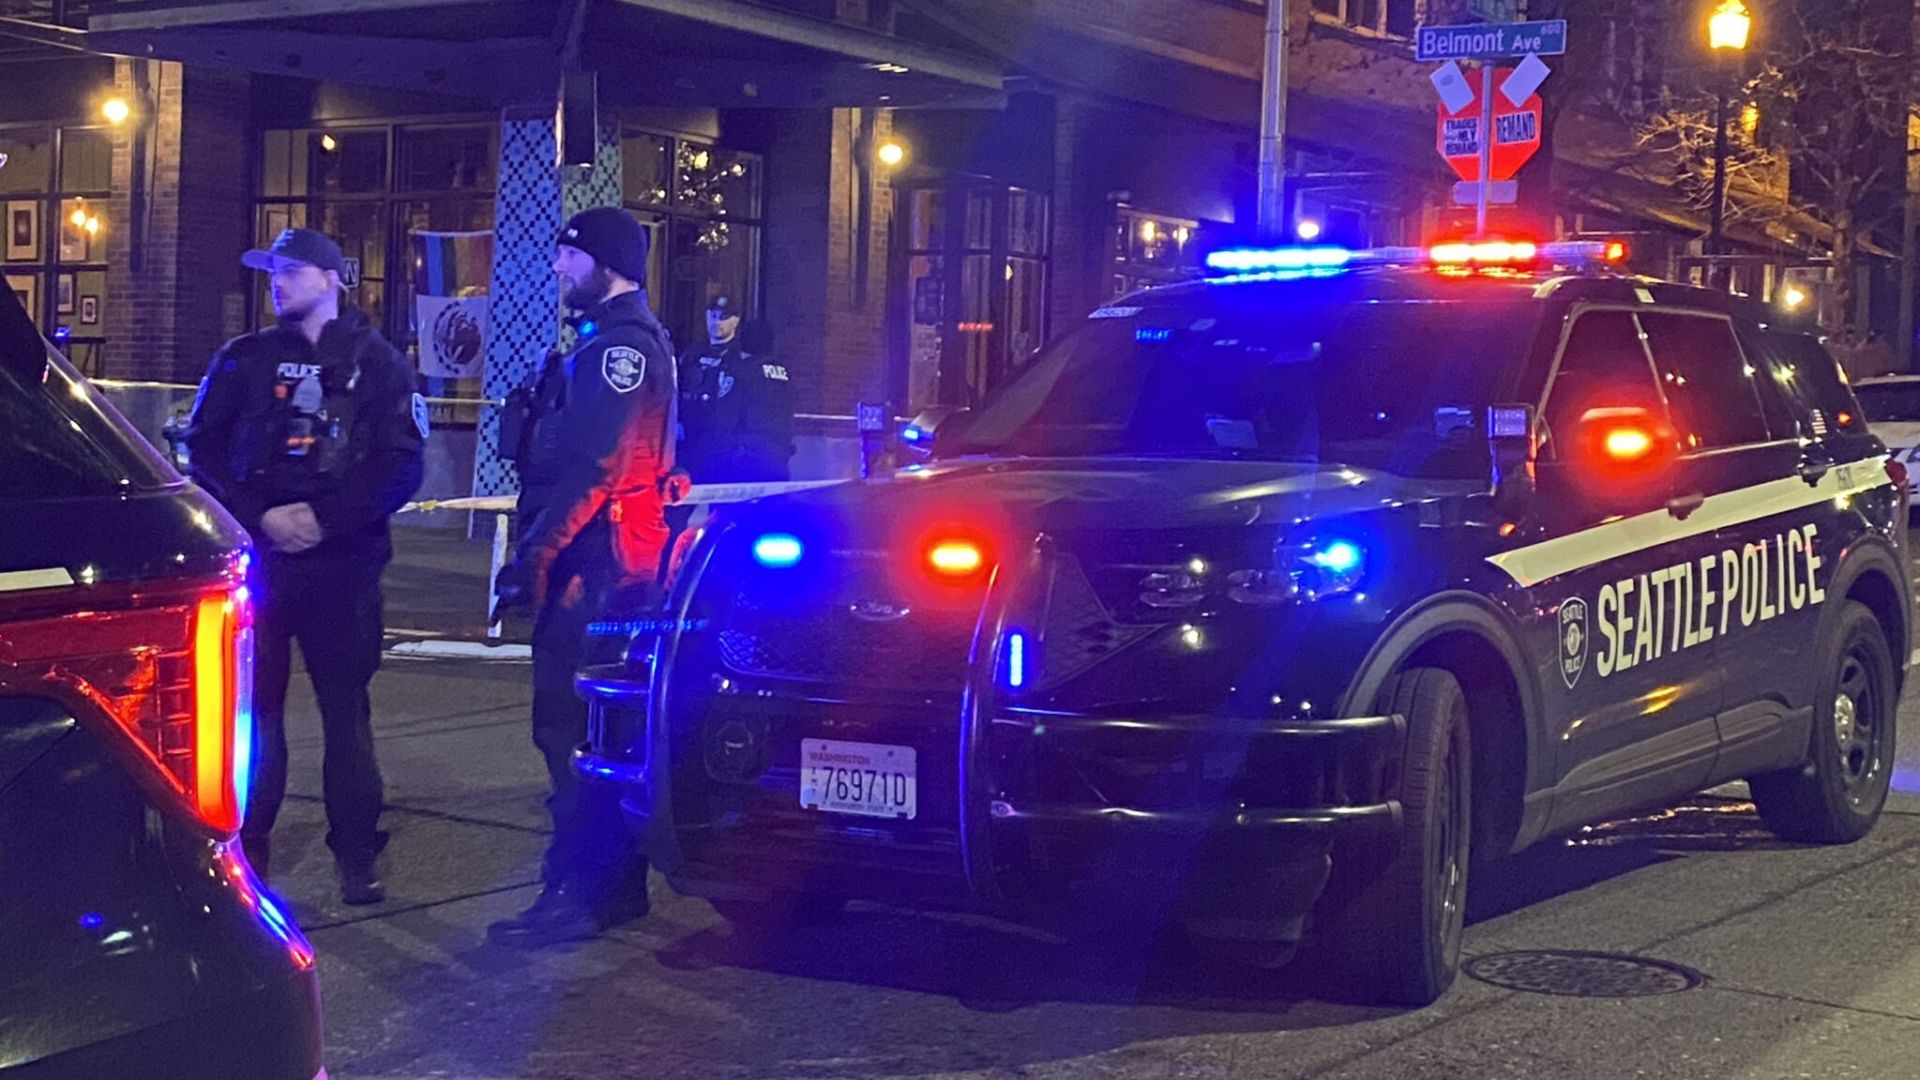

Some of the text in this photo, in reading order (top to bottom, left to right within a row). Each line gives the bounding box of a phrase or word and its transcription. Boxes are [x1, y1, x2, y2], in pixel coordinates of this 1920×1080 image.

[1423, 28, 1504, 54] Belmont
[1511, 35, 1541, 50] Ave
[277, 362, 321, 379] POLICE
[762, 364, 789, 381] POLICE
[1597, 523, 1826, 678] SEATTLE POLICE
[822, 766, 906, 806] 76971D
